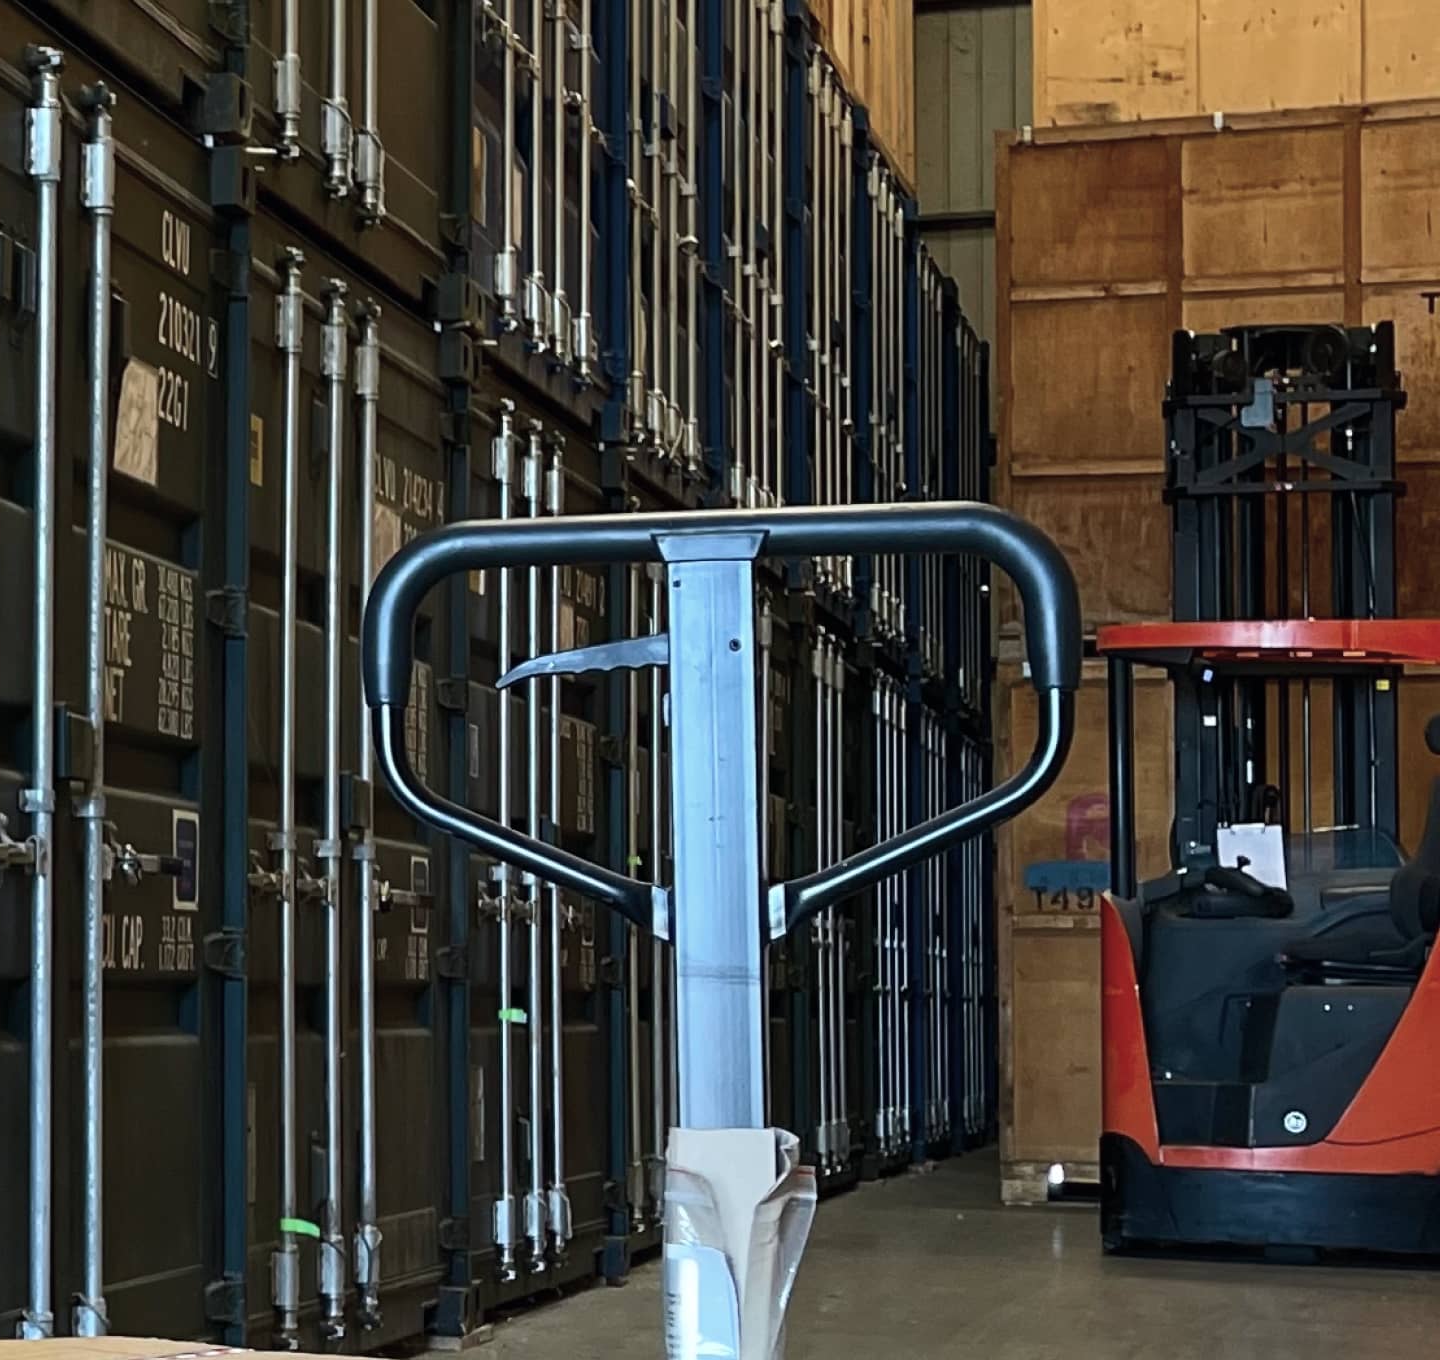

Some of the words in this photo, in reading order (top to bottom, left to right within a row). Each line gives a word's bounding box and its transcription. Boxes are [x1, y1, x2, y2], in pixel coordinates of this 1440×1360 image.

[162, 209, 191, 276] CLVU
[158, 291, 201, 366] 210321
[158, 366, 189, 432] 22G1
[104, 607, 132, 667] TARE
